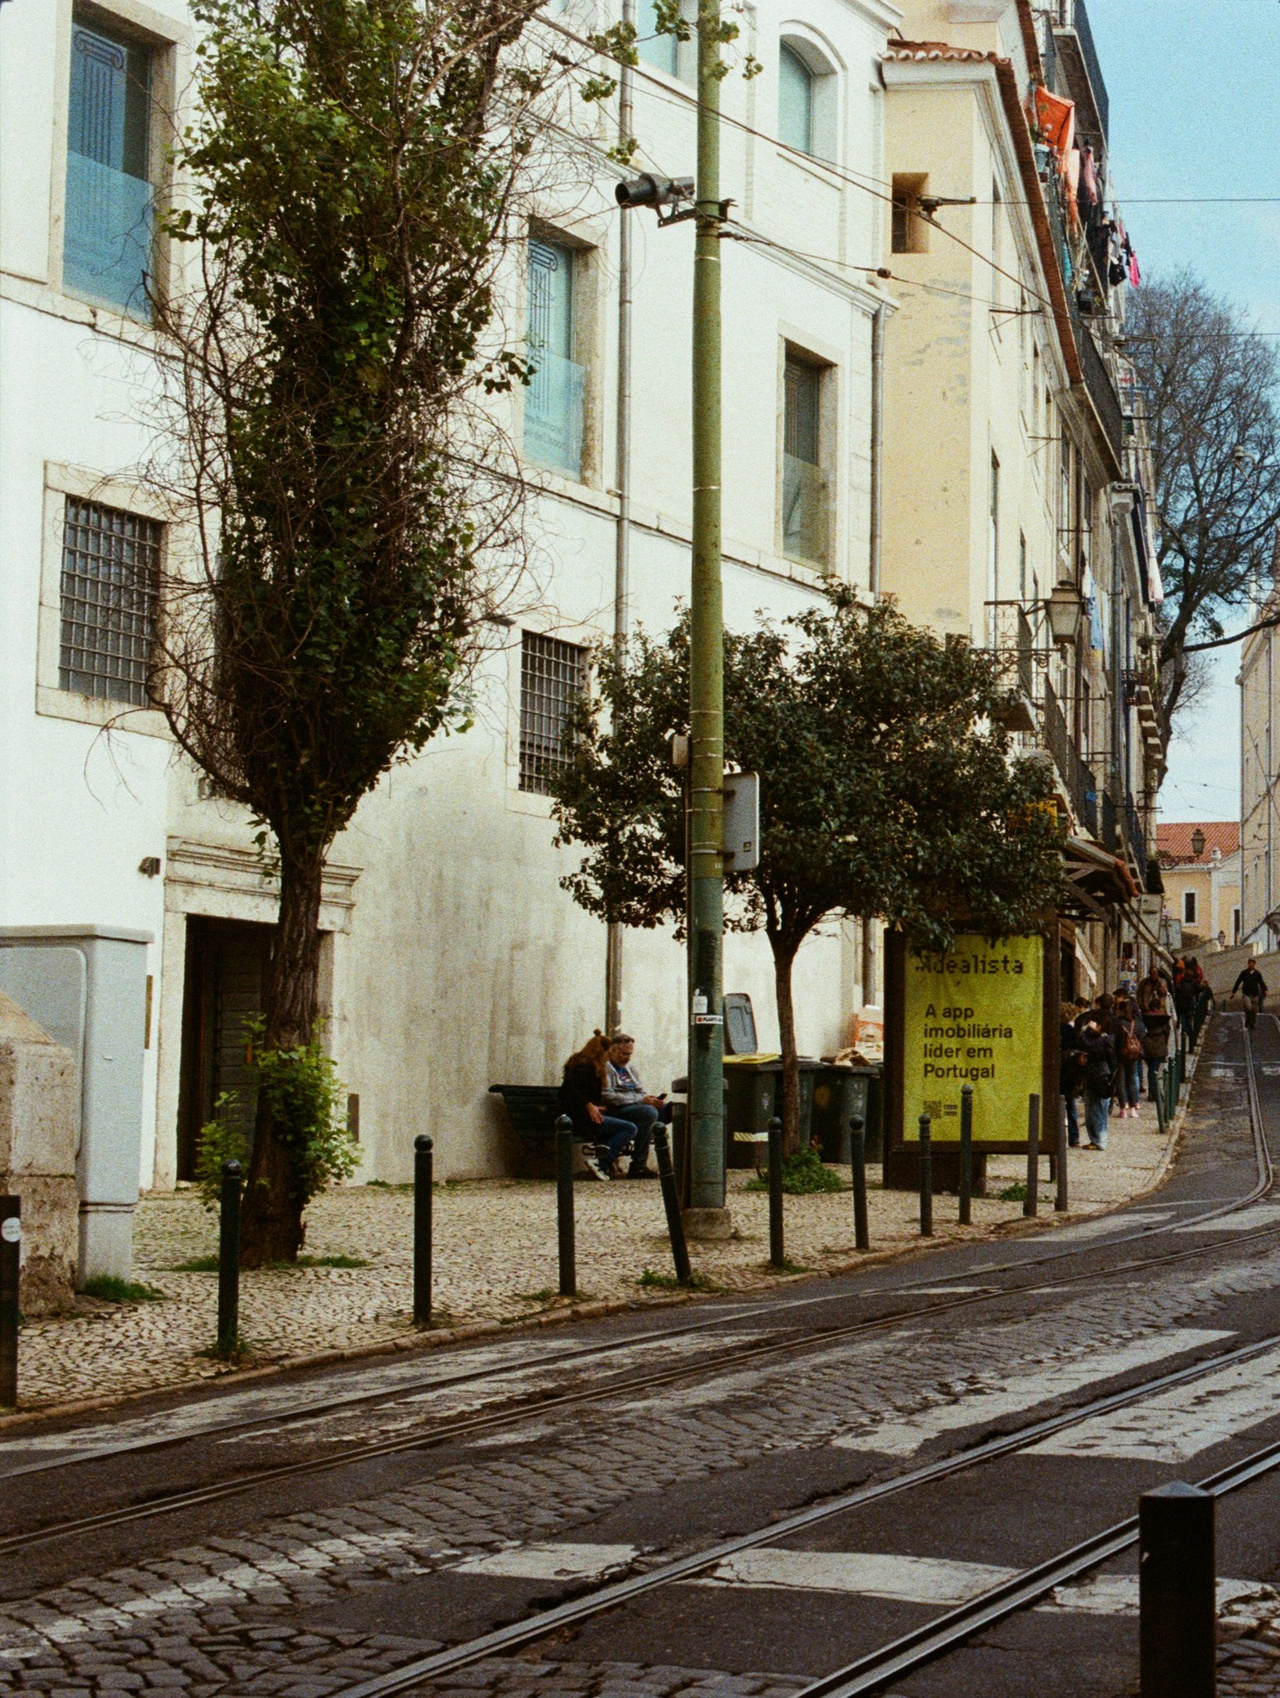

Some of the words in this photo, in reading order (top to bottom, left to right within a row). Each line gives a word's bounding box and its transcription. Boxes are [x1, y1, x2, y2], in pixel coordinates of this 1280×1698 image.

[925, 1003, 937, 1018] A
[942, 1007, 974, 1021] app
[924, 1023, 1013, 1038] imobiliária
[923, 1043, 961, 1058] líder
[966, 1047, 993, 1058] em
[924, 1063, 995, 1081] Portugal
